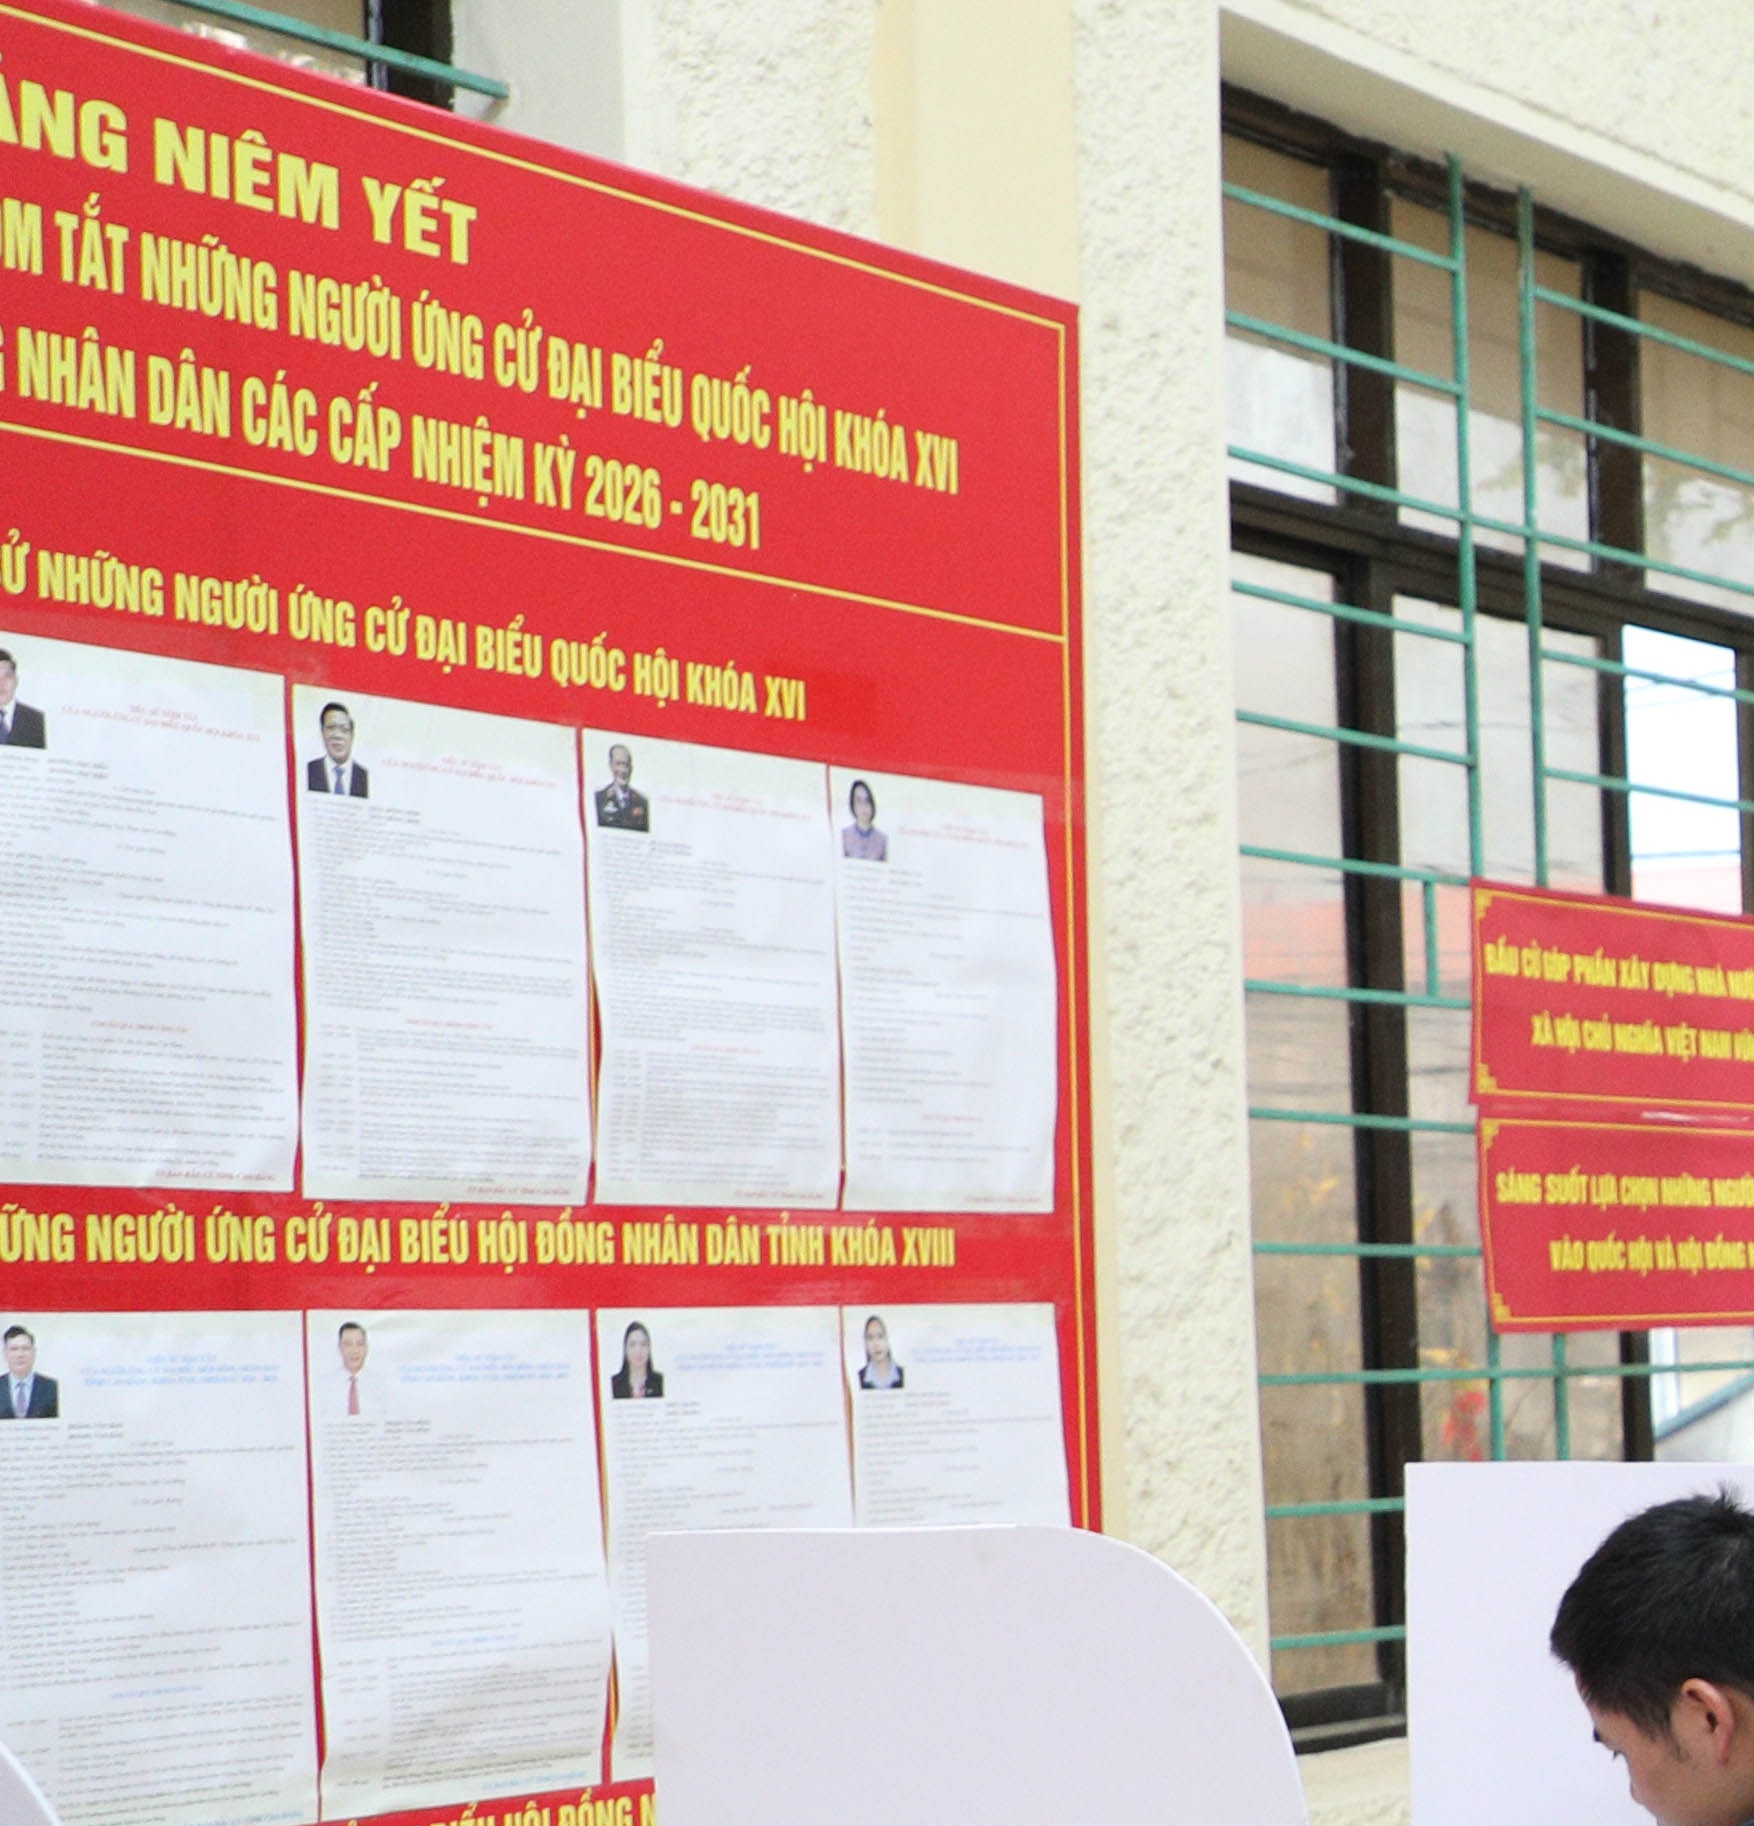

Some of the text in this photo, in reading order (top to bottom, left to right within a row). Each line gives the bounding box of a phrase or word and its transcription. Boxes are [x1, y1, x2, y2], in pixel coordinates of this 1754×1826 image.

[154, 118, 340, 230] NIÊM
[362, 175, 478, 266] YẾT
[17, 326, 136, 419] NHÂN
[148, 348, 231, 438] DÂN
[242, 369, 318, 457] CÁC
[329, 382, 402, 473] CẤP
[412, 415, 525, 508] NHIỆM
[534, 435, 577, 511] KỲ
[585, 455, 662, 530] 2026
[691, 479, 760, 550] 2031
[54, 192, 129, 294] TẮT
[141, 232, 278, 331] NHỮNG
[288, 270, 401, 361] NGƯỜI
[412, 289, 485, 381] ỨNG
[494, 308, 543, 394] CỬ
[547, 336, 602, 420] ĐẠI
[611, 338, 683, 428] BIỂU
[691, 364, 771, 449] QUỐC
[779, 388, 828, 473] HỘI
[834, 408, 910, 484] KHÓA
[915, 430, 959, 495] XVI
[0, 528, 806, 721] Ử NHỮNG NGƯỜI ỨNG CỬ ĐẠI BIỂU QUỐC HỘI KHÓA XVI
[86, 1202, 195, 1263] NGƯỜI
[206, 1205, 276, 1263] ỨNG
[286, 1201, 333, 1264] CỬ
[337, 1217, 391, 1274] ĐẠI
[399, 1201, 470, 1265] BIỂU
[477, 1210, 529, 1274] HỘI
[535, 1206, 615, 1265] ĐỒNG
[622, 1213, 700, 1265] NHÂN
[706, 1215, 761, 1266] DÂN
[765, 1211, 825, 1266] TỈNH
[829, 1218, 897, 1267] KHÓA
[902, 1226, 956, 1267] XVIII
